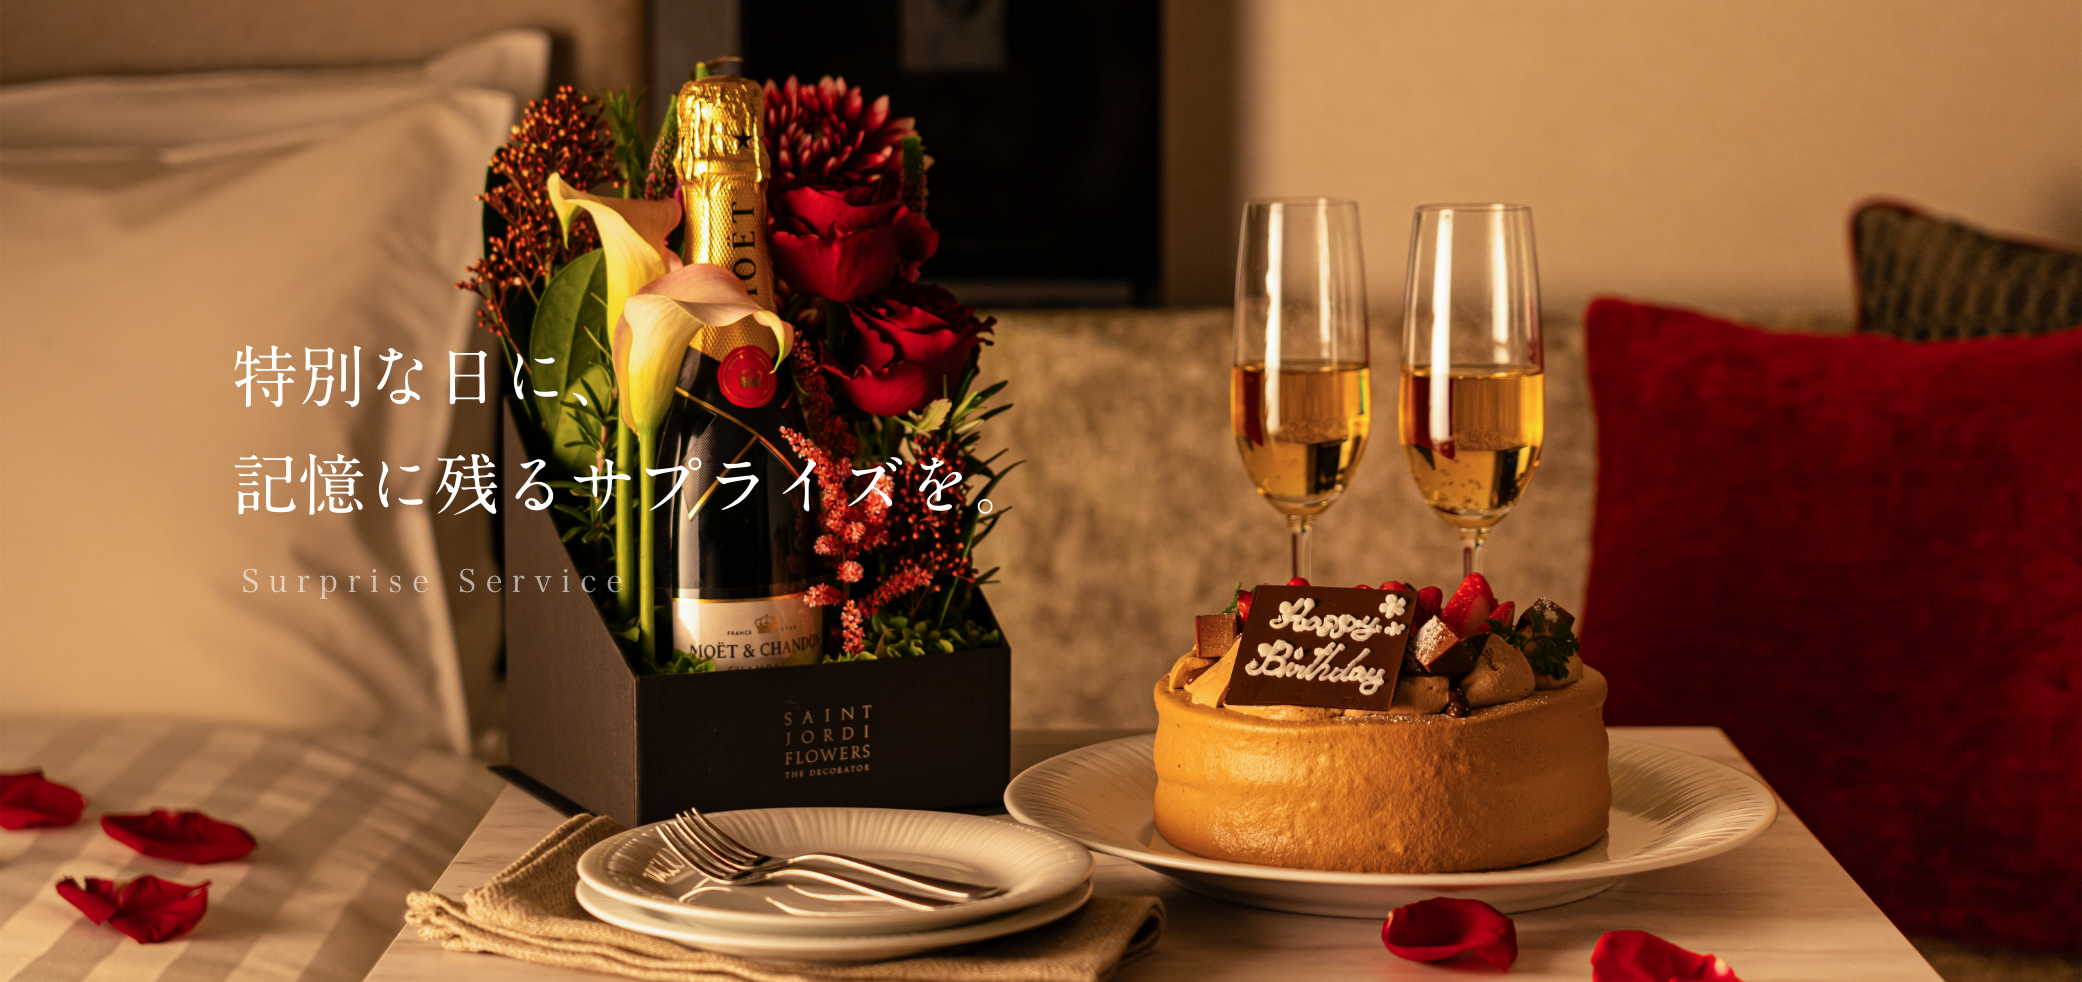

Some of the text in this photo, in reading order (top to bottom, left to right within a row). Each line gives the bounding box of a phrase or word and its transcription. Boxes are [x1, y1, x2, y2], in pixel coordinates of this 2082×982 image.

[727, 202, 758, 296] OËT
[1269, 597, 1382, 641] Happy
[690, 632, 820, 659] MOËT & CHANDON
[1245, 639, 1386, 695] Birthday
[784, 705, 872, 726] SAINT
[786, 725, 869, 746] JORDI
[785, 744, 870, 765] FLOWERS
[785, 764, 870, 779] THE DECORATOR
